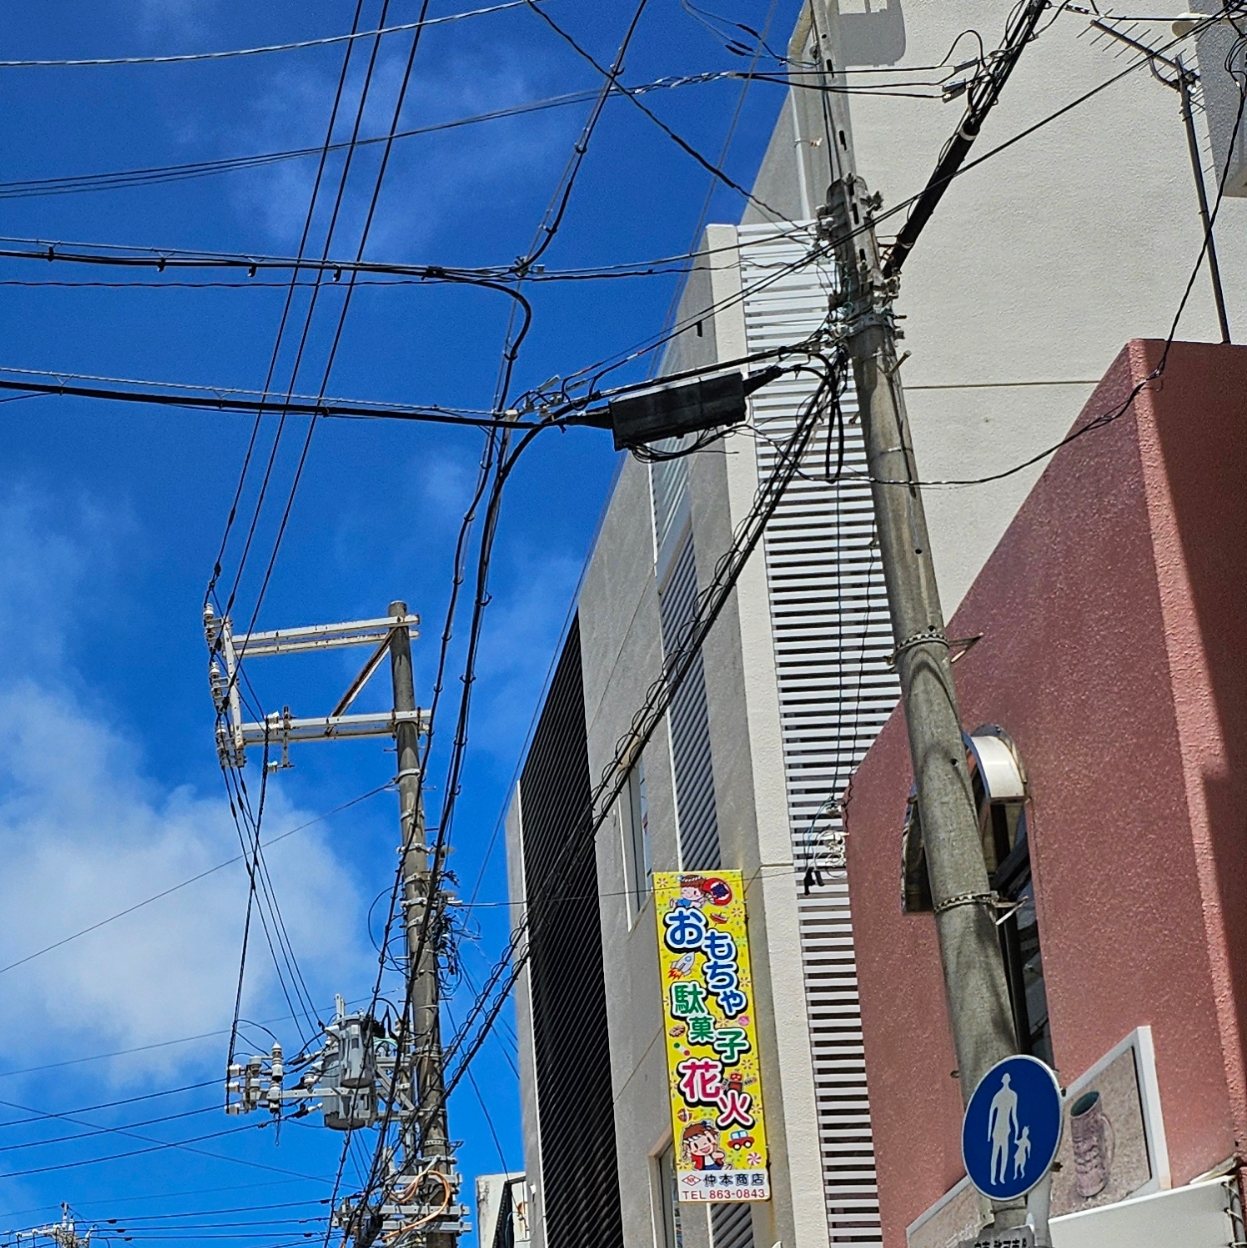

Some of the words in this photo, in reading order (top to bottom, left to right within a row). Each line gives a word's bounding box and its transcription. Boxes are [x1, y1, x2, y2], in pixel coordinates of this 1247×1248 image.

[663, 904, 746, 1020] おもちゃ
[672, 980, 750, 1066] 駄菓子
[679, 1059, 753, 1127] 花火
[682, 1190, 706, 1200] TEL
[709, 1188, 766, 1199] 863-0843
[703, 1173, 765, 1187] 仲本商店
